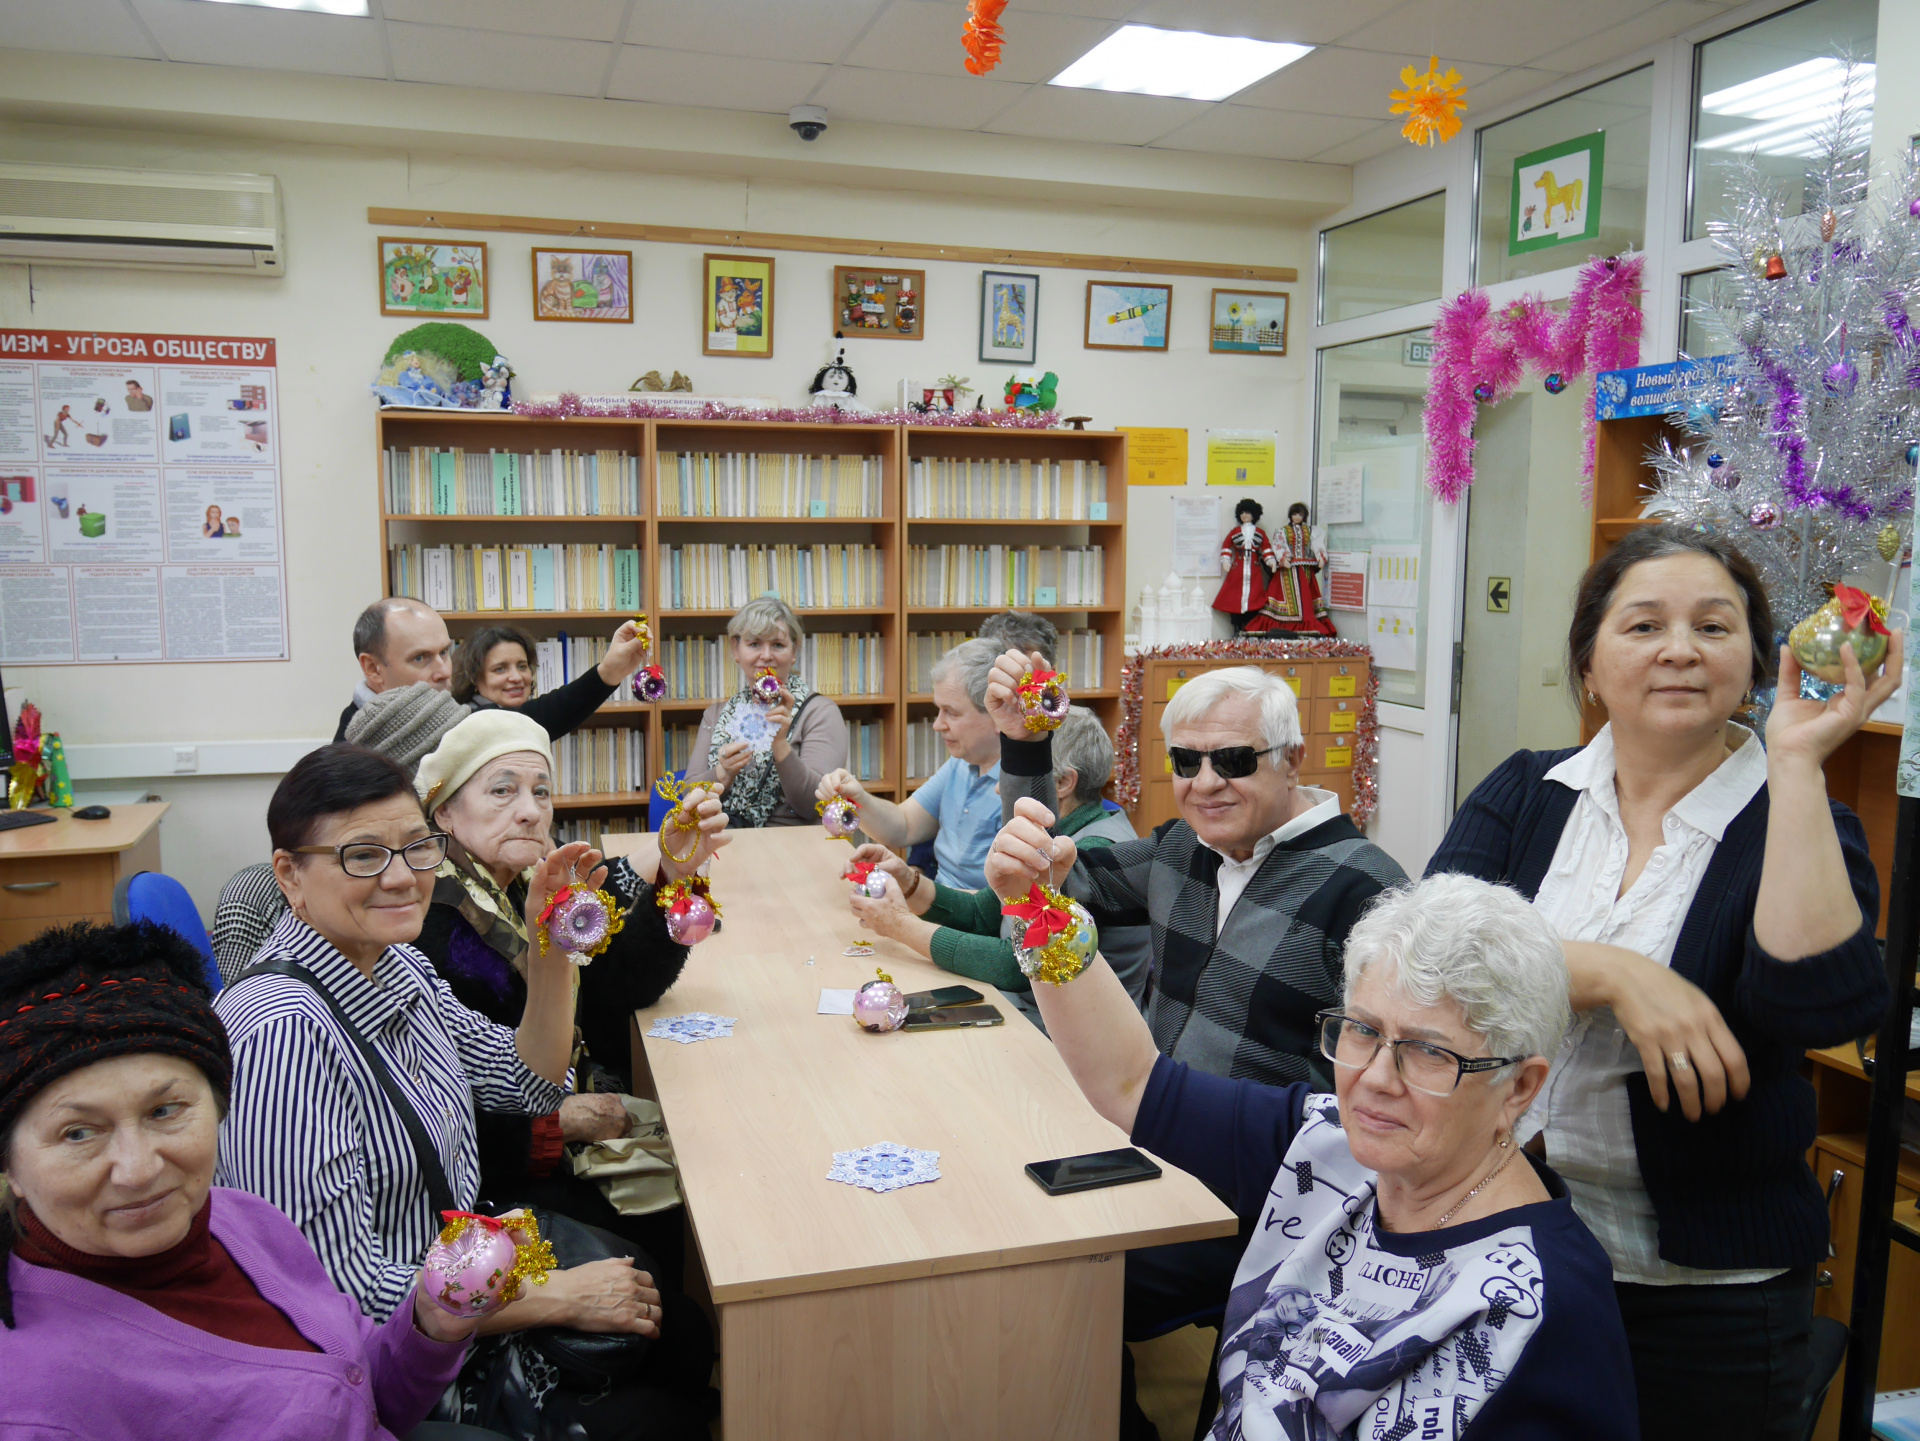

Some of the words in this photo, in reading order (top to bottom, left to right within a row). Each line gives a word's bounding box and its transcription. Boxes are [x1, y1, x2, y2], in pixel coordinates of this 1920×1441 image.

[0, 333, 48, 353] ИЗМ
[66, 336, 148, 357] УГРОЗА
[152, 339, 267, 361] ОБЩЕСТВУ
[1635, 369, 1675, 388] Новый
